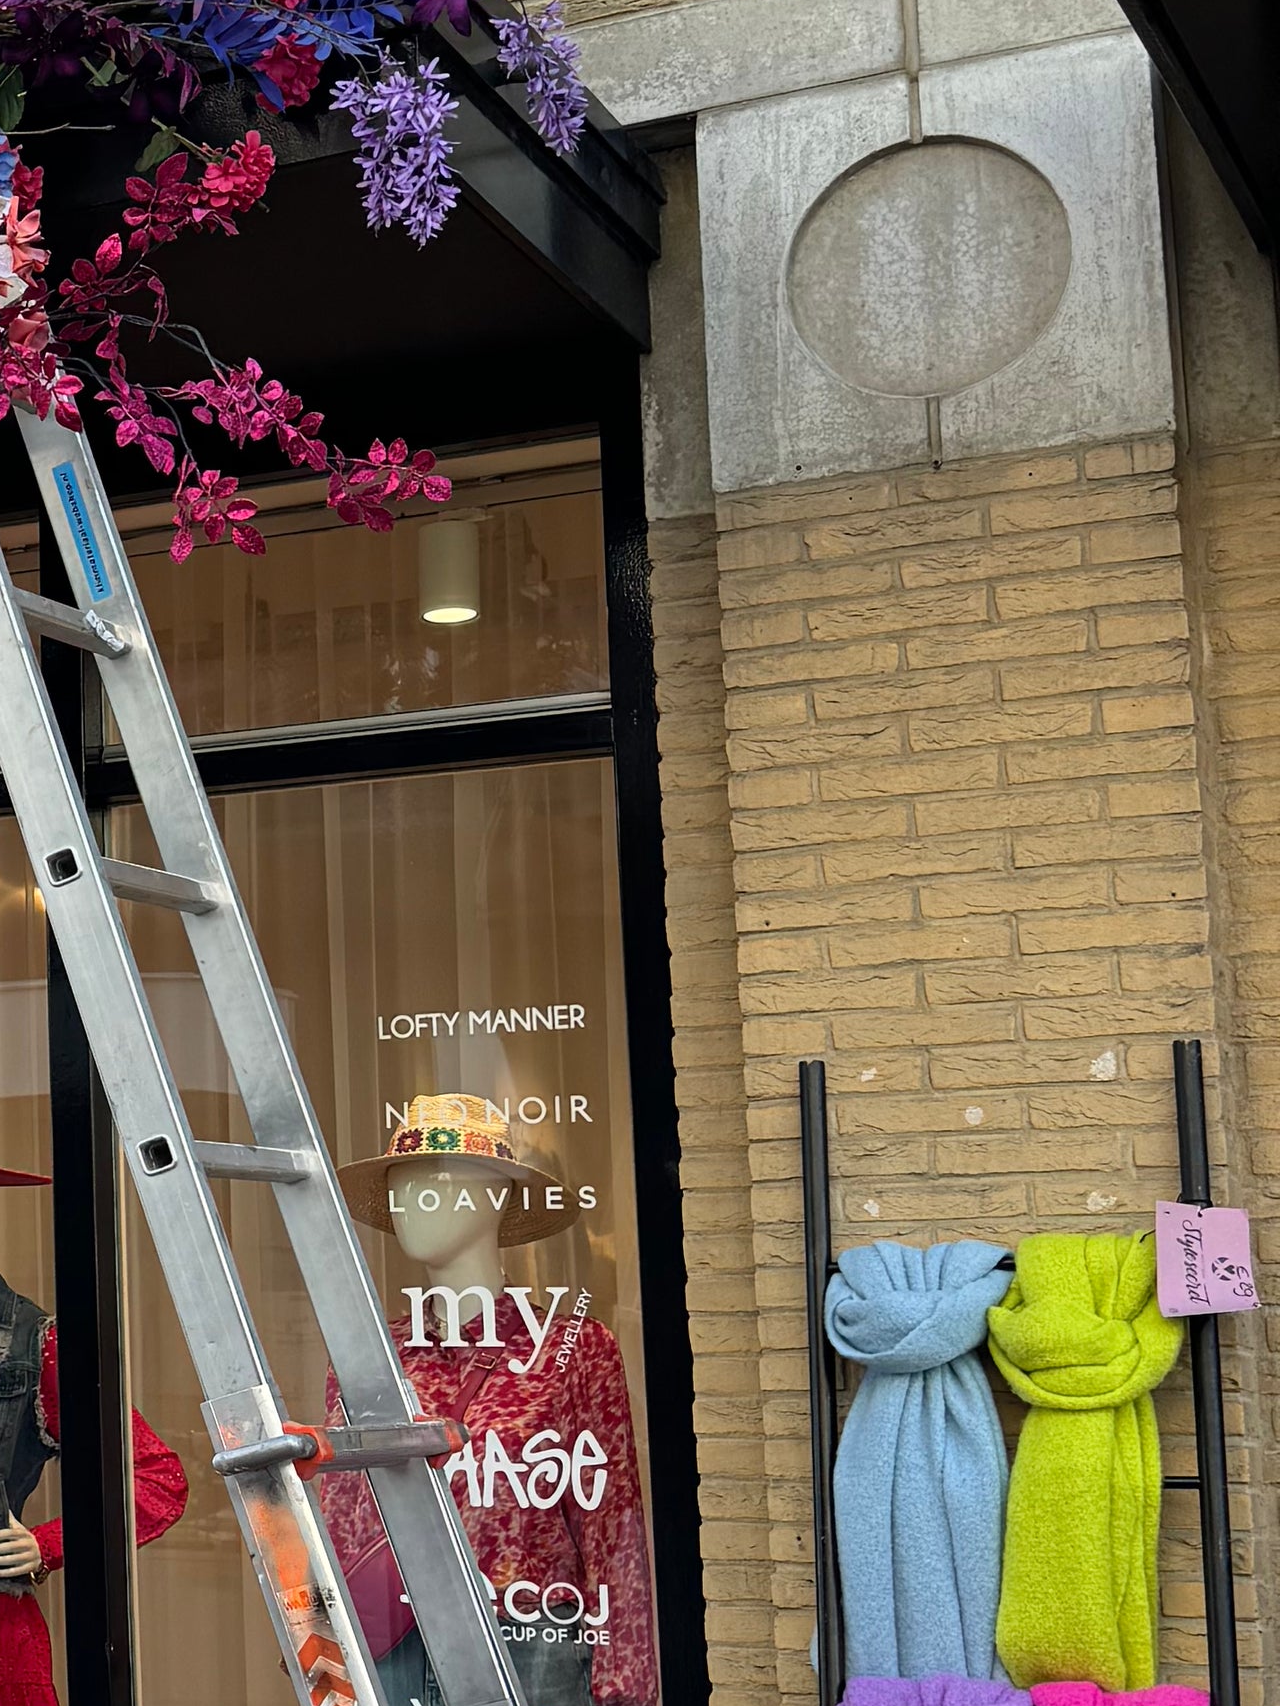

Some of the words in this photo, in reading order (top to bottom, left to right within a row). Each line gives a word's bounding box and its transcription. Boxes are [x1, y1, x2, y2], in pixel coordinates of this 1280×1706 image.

[377, 1011, 461, 1041] LOFTY
[468, 1004, 587, 1035] MANNER
[484, 1094, 594, 1126] NOIR
[388, 1186, 599, 1215] LOAVIES
[400, 1284, 571, 1376] my
[553, 1286, 594, 1374] JEWELLERY
[500, 1625, 537, 1643] CUP
[541, 1627, 569, 1644] OF
[573, 1628, 611, 1646] JOE
